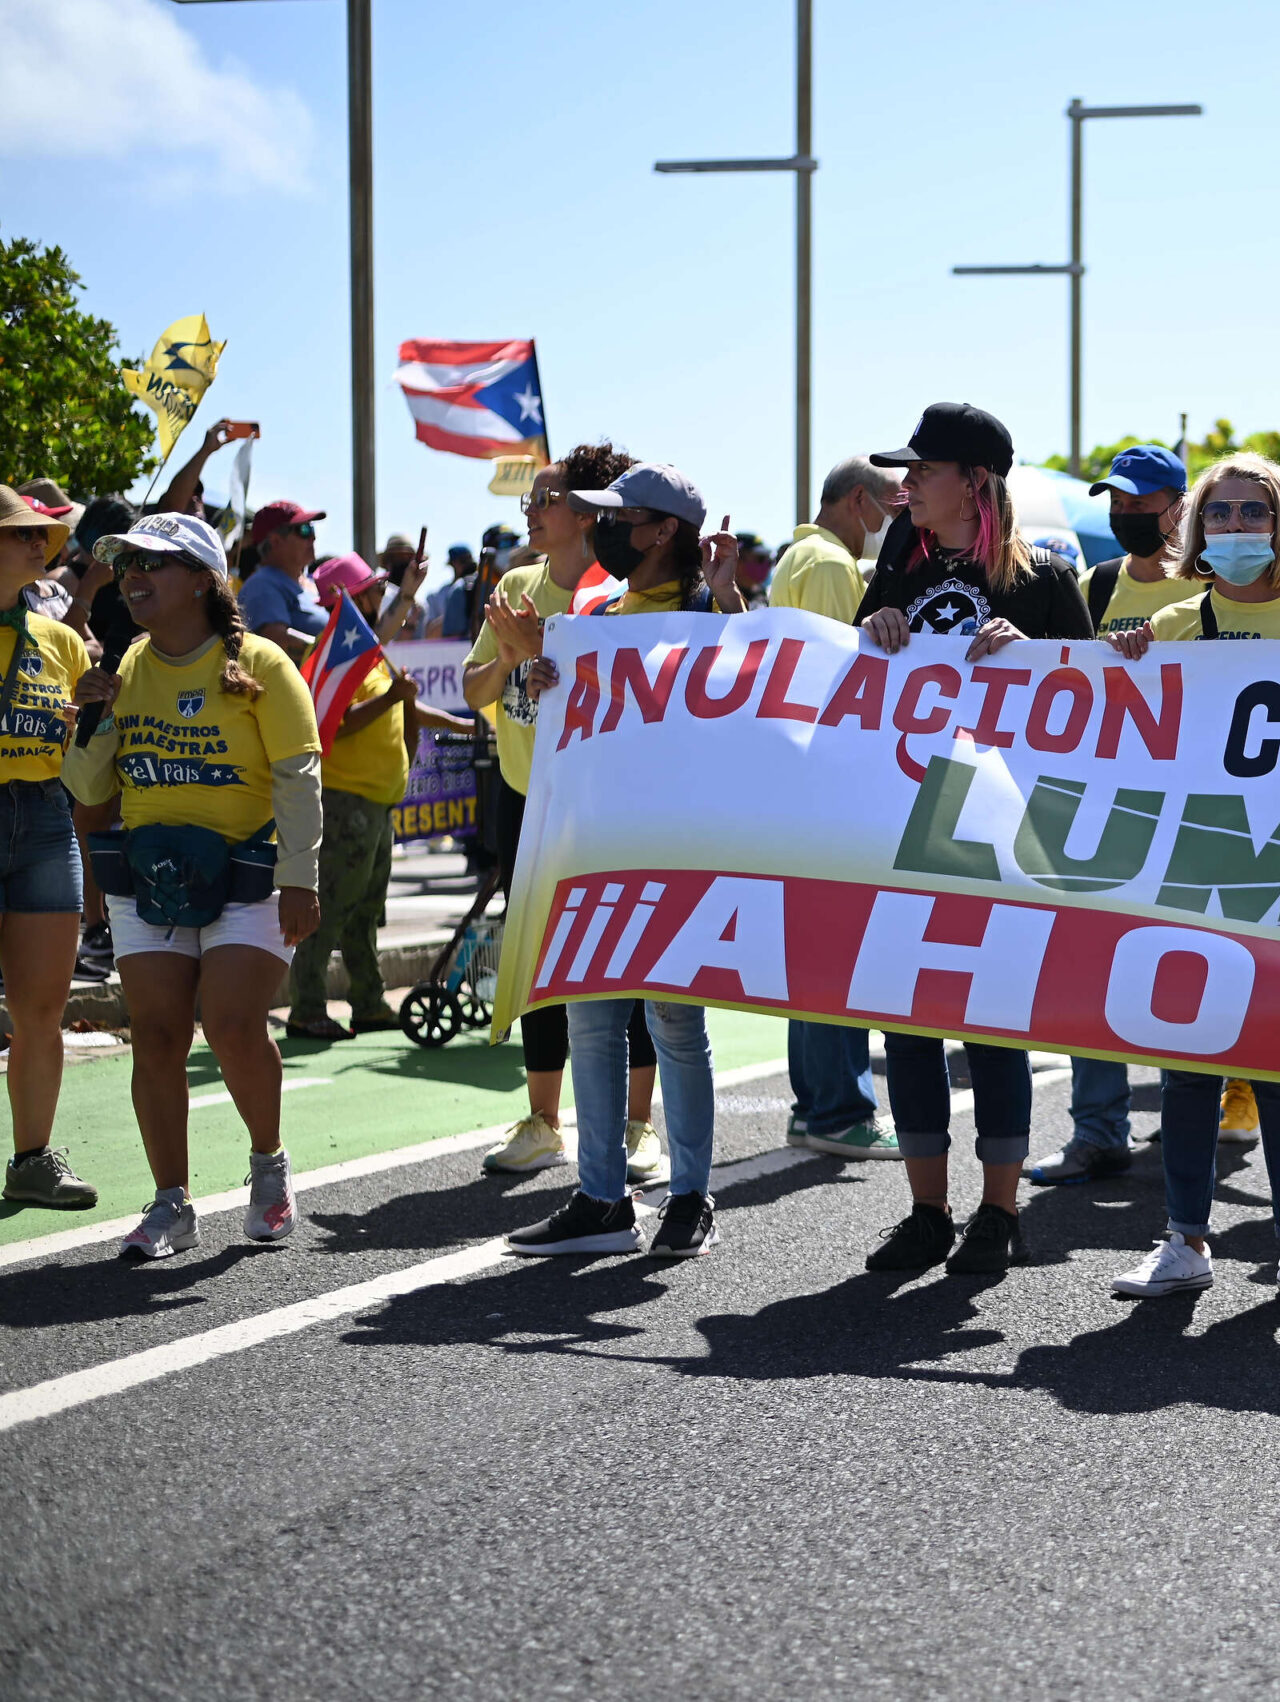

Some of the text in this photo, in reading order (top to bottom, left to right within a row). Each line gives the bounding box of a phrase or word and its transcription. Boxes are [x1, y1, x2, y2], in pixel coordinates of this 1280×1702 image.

[556, 638, 1183, 761] ANULACIÓN
[118, 714, 221, 738] SIN MAESTROS
[130, 731, 228, 755] MAESTRAS
